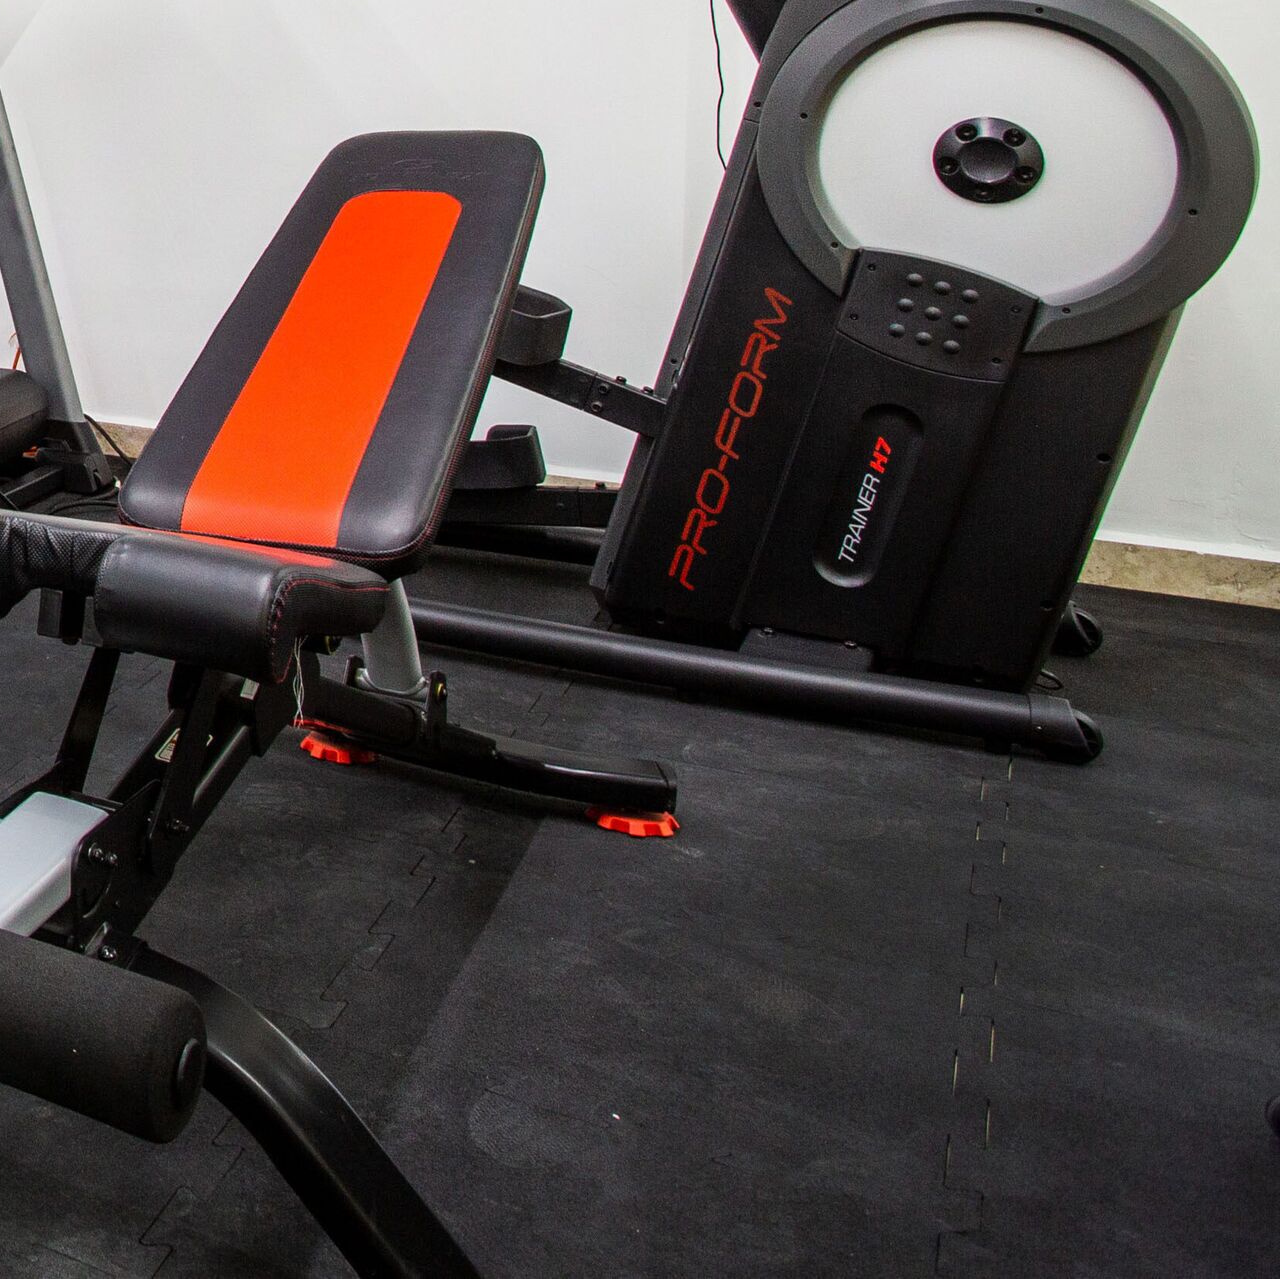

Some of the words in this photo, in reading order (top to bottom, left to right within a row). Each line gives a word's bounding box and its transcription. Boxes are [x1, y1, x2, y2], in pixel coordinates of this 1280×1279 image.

[668, 287, 792, 591] PRO-FORM
[838, 472, 880, 562] TRAINER
[870, 436, 892, 473] H7
